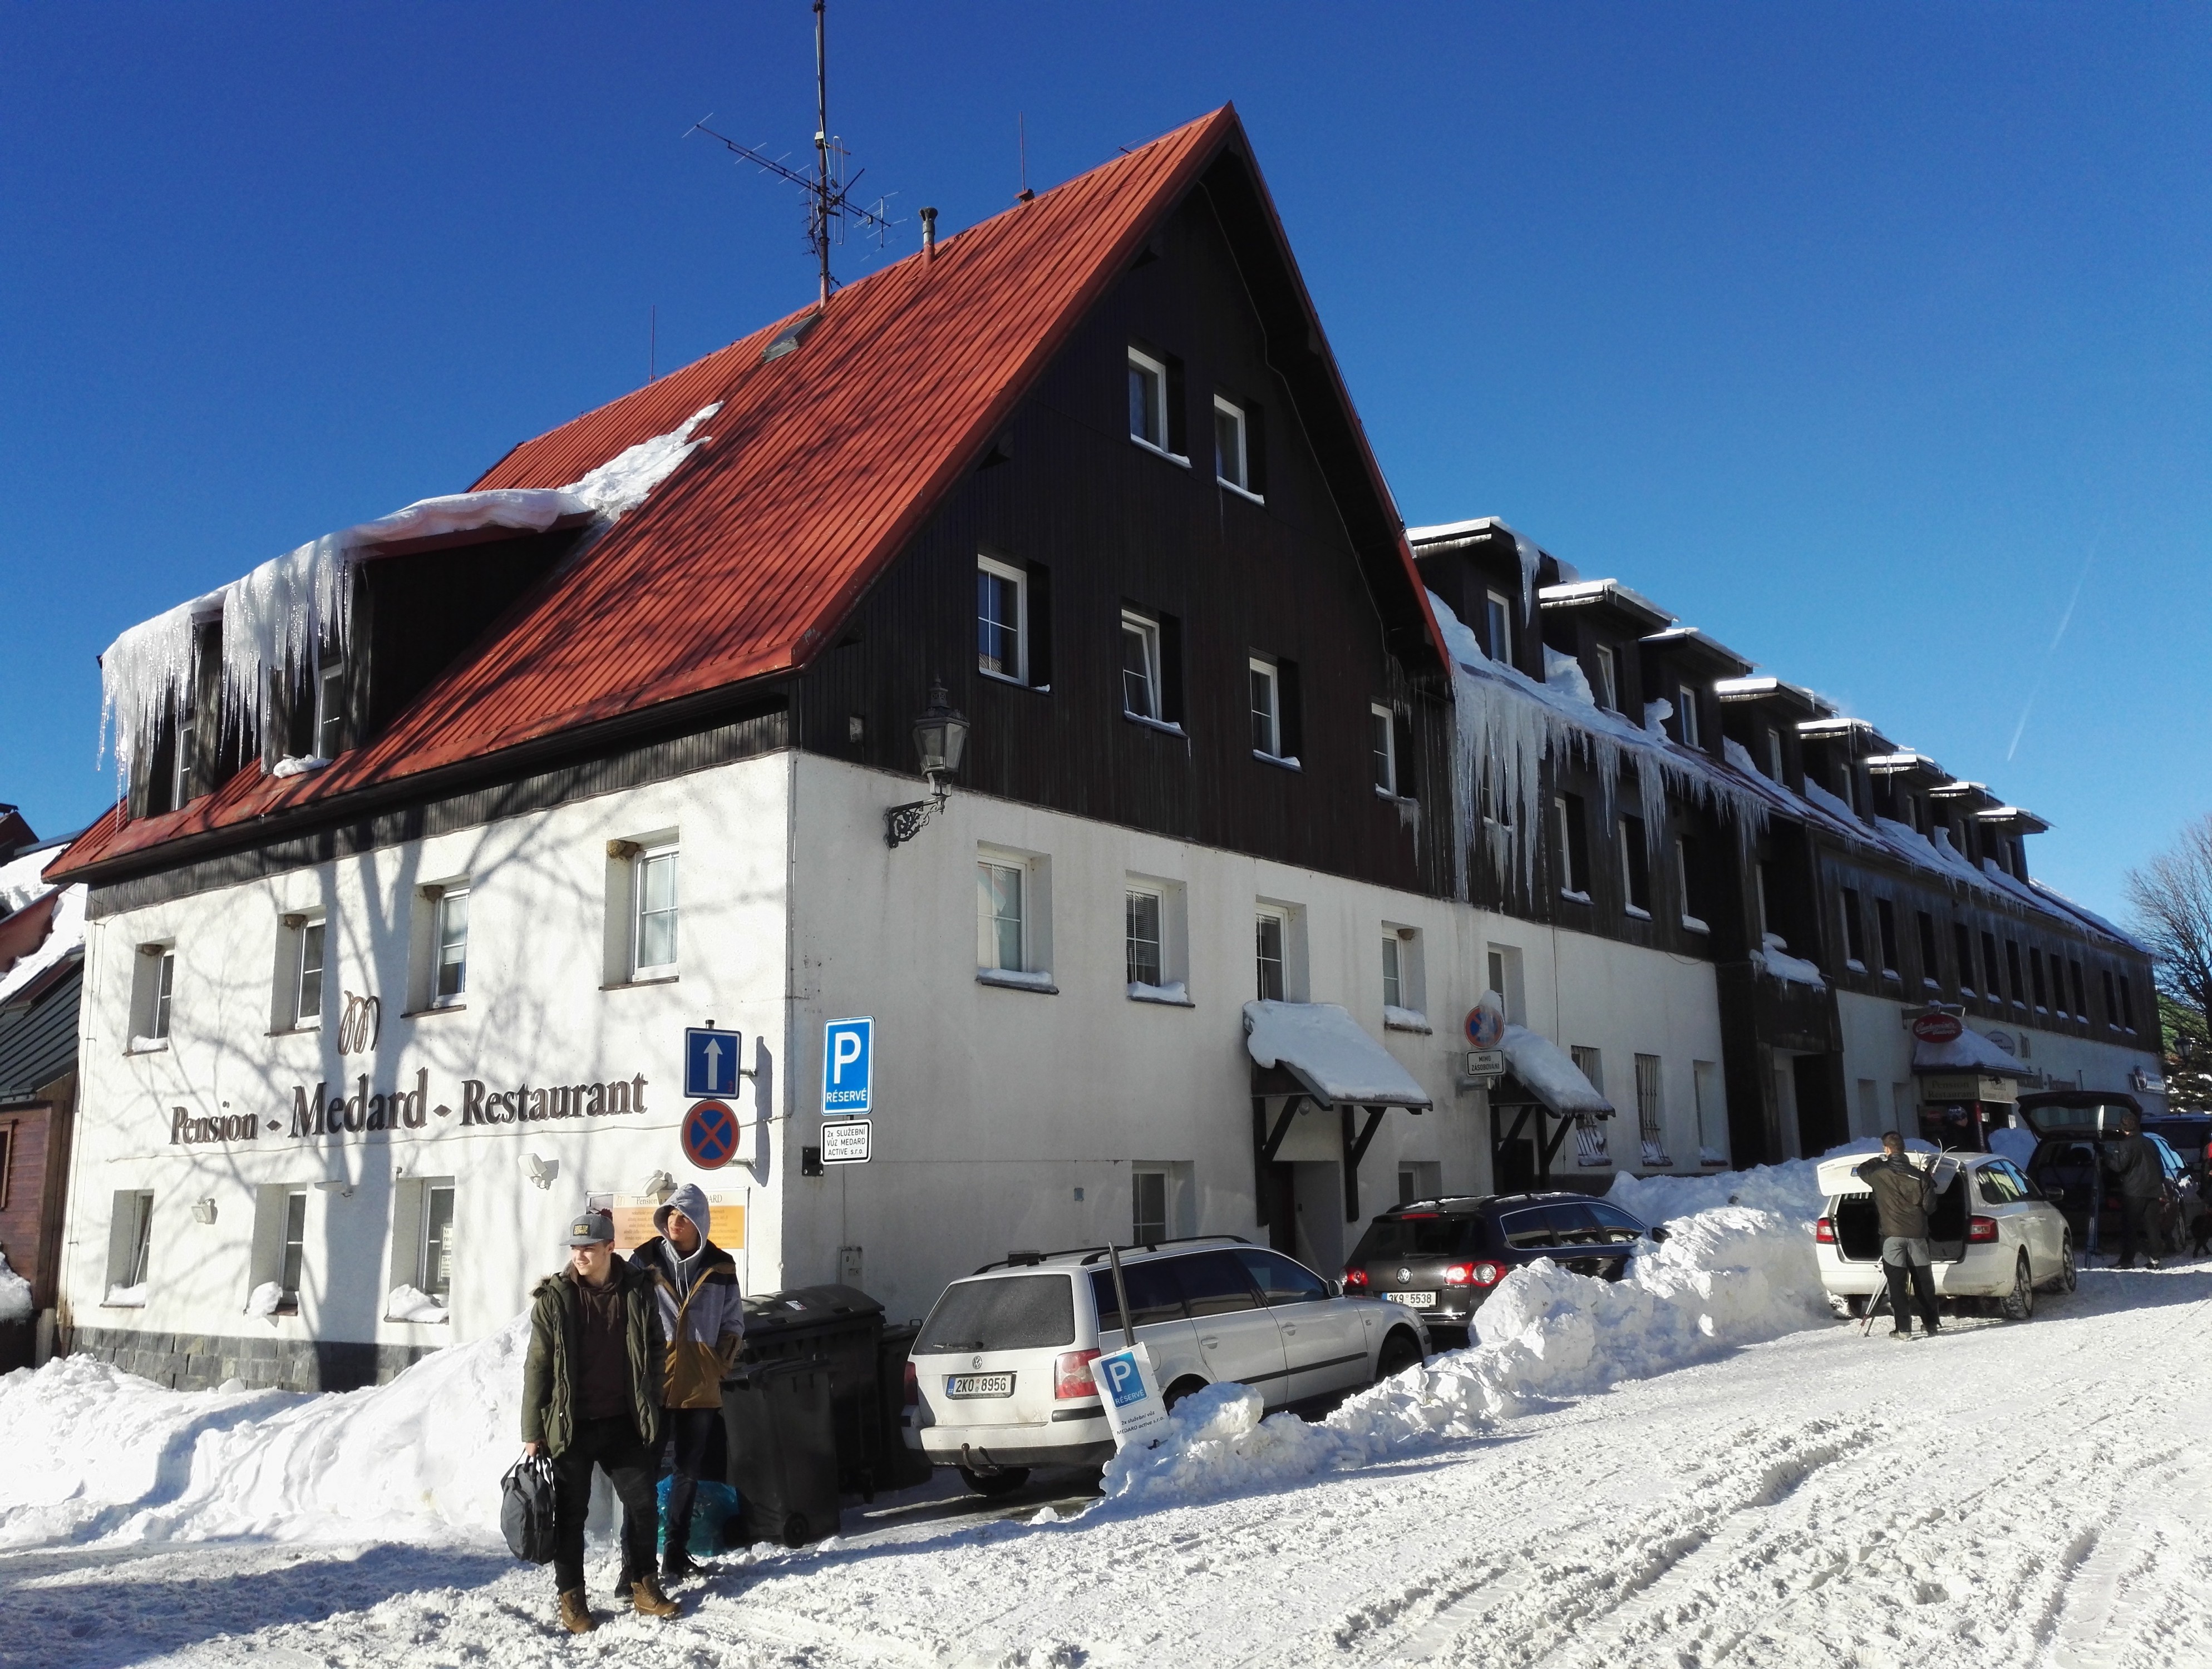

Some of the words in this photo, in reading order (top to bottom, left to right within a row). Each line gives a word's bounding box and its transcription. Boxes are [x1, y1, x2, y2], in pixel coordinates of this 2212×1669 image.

[834, 1031, 861, 1084] P
[826, 1087, 866, 1103] RÉSERVÉ
[169, 1101, 258, 1145] Pension
[287, 1066, 427, 1138] Medard
[459, 1072, 648, 1126] Restaurant
[836, 1126, 865, 1137] SLUŽEBNÍ
[827, 1138, 837, 1147] VŮZ
[1410, 1294, 1432, 1303] 5538
[981, 1377, 1006, 1391] 8956
[1109, 1361, 1131, 1392] P
[1115, 1389, 1145, 1404] RÉSERVÉ
[1127, 1413, 1146, 1424] služební
[1117, 1425, 1138, 1435] MEDARD
[1139, 1420, 1152, 1429] active
